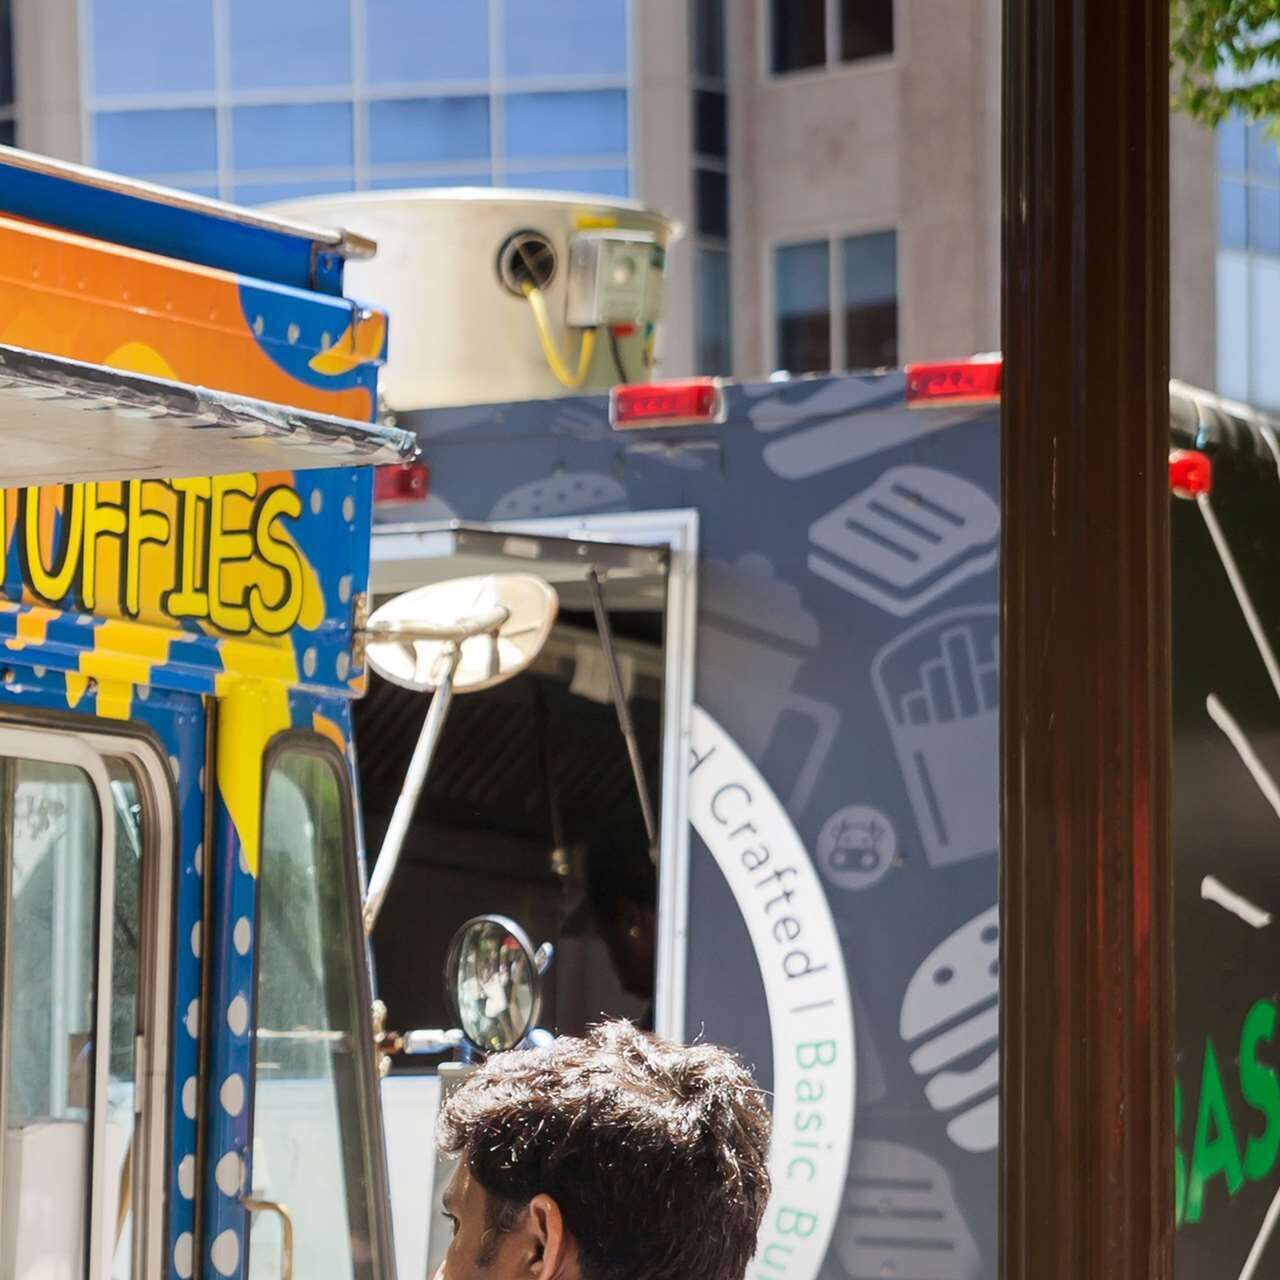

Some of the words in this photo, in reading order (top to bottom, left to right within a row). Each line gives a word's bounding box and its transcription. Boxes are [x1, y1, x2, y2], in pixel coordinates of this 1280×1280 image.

[710, 782, 829, 981] Crafted
[788, 1039, 837, 1182] Basic
[1175, 998, 1280, 1230] AS
